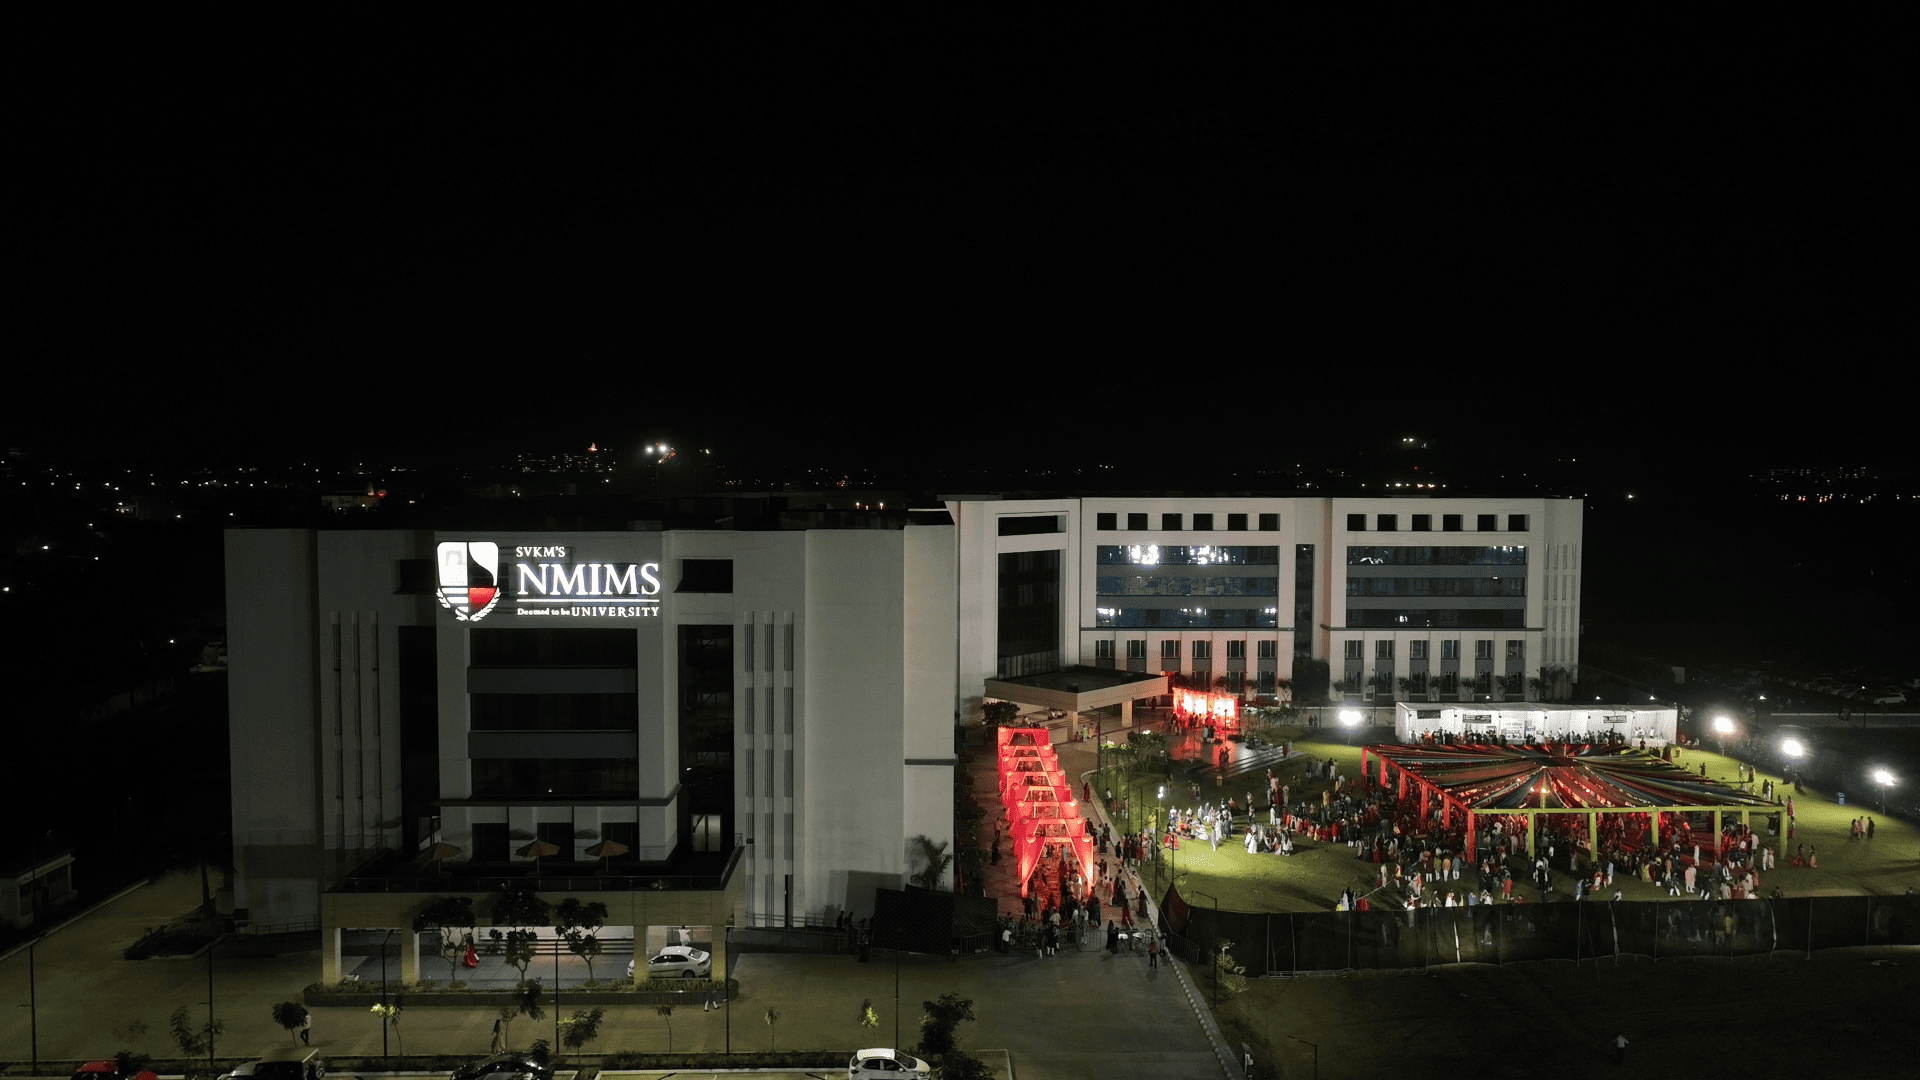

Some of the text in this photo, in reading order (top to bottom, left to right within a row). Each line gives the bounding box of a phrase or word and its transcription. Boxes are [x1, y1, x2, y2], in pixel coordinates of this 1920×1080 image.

[515, 545, 566, 558] SVKM'S
[516, 562, 661, 596] NMIMS
[517, 606, 660, 618] Deemed to be UNIVERSITY
